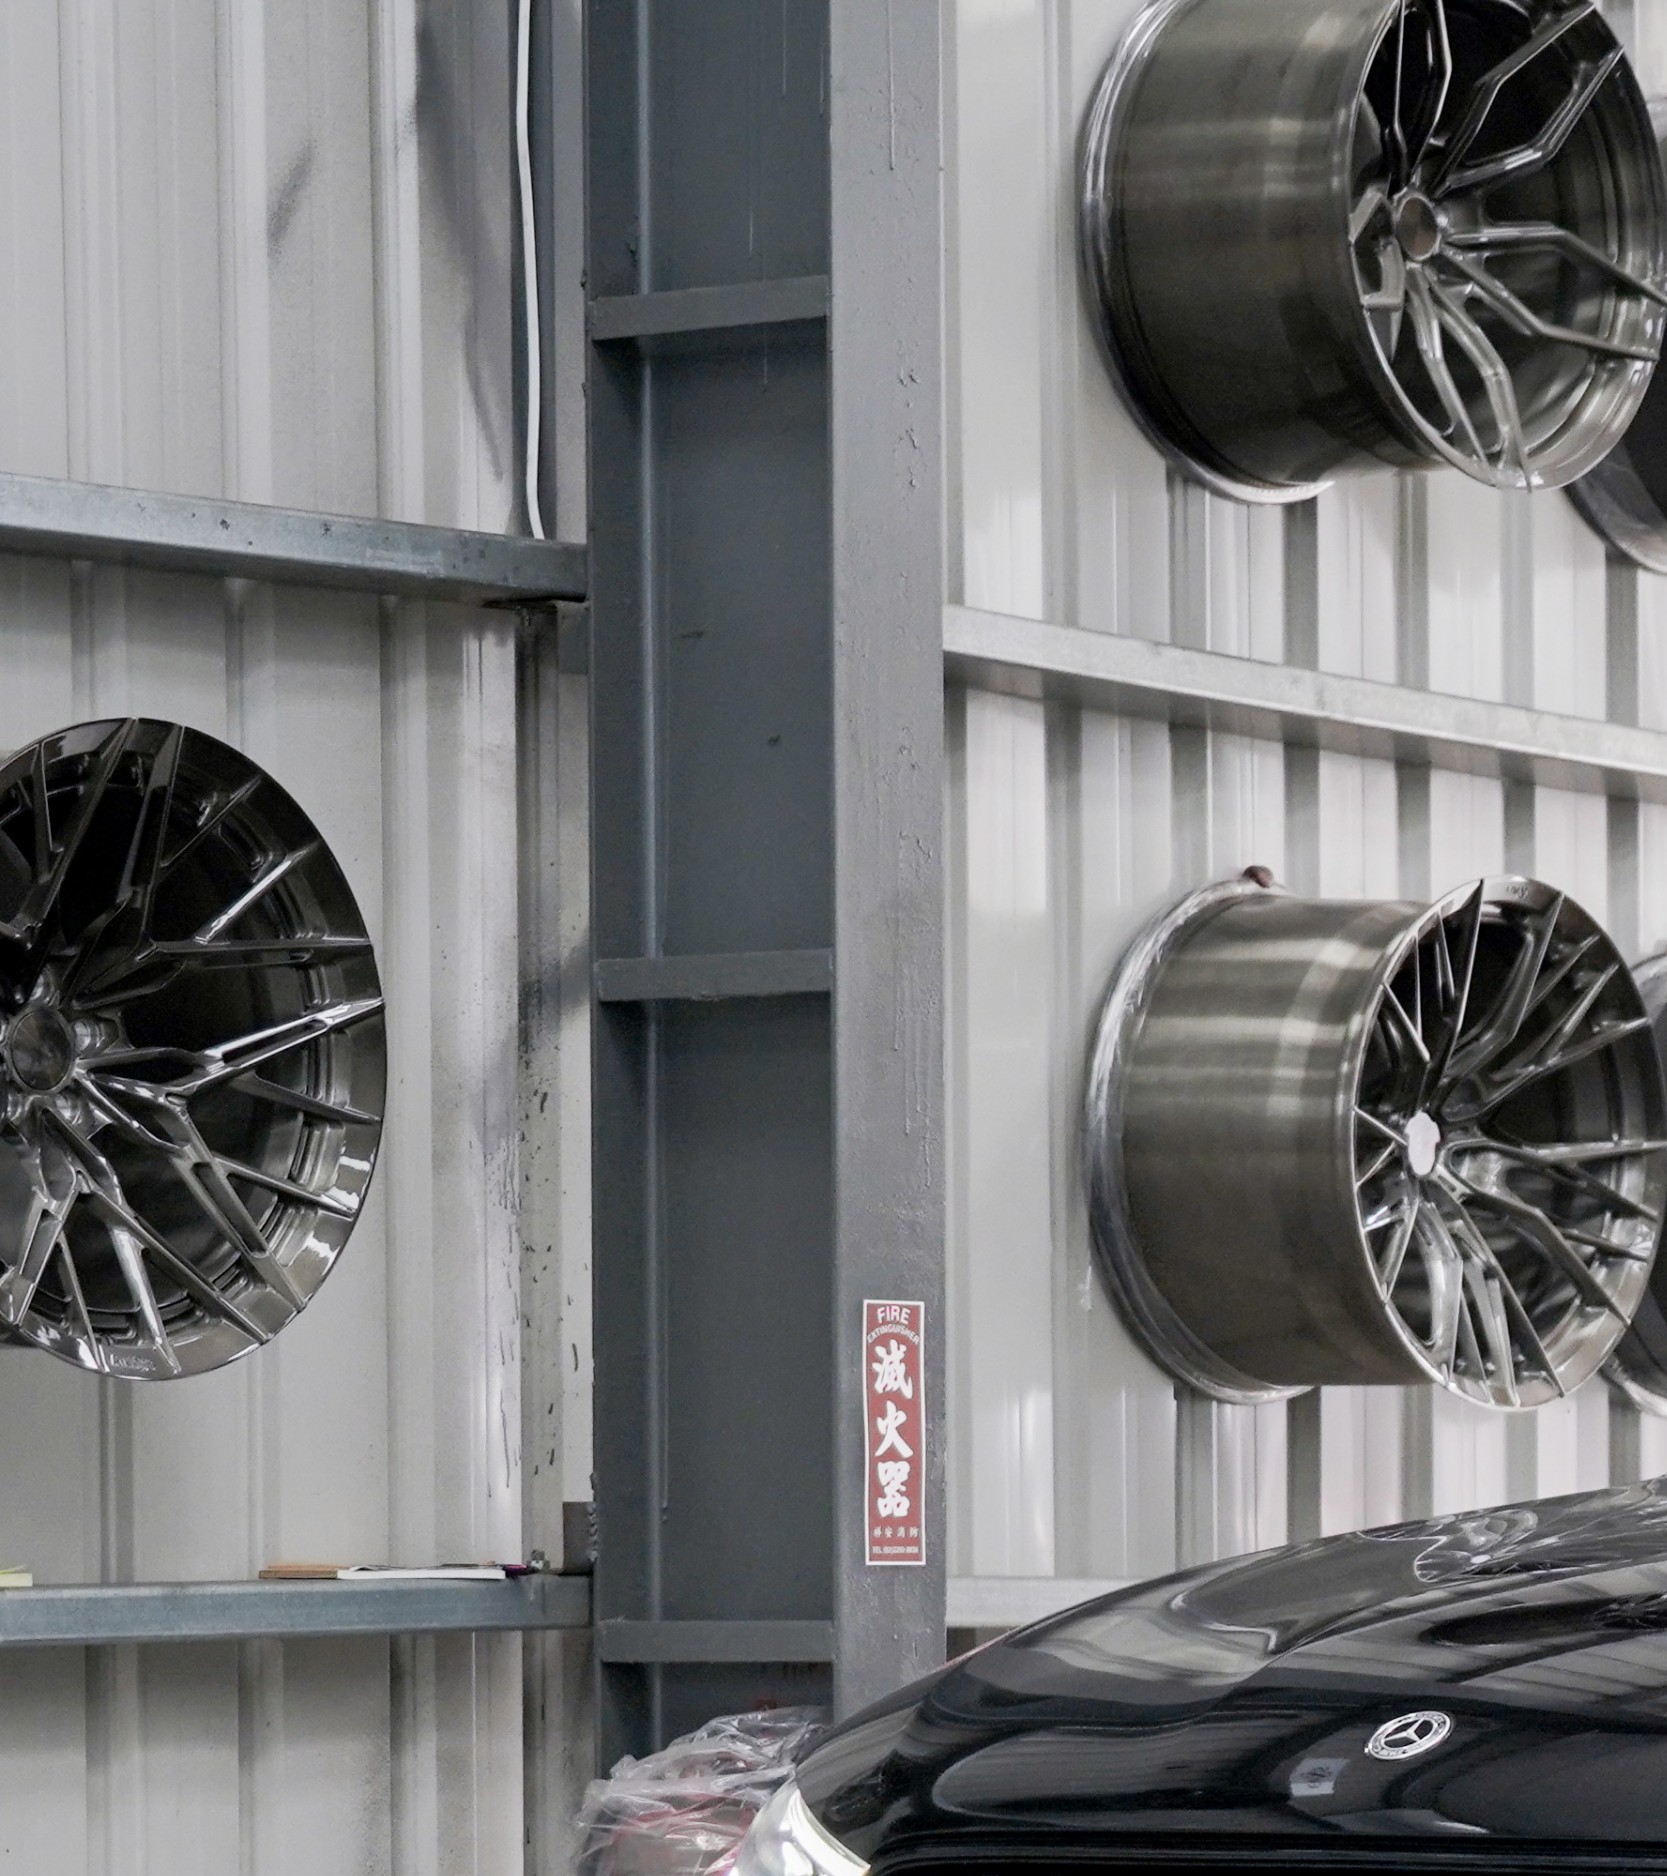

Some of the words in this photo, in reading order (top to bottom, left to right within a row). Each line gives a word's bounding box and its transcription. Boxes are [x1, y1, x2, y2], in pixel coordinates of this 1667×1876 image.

[877, 1305, 911, 1325] FIRE
[867, 1323, 920, 1345] EXTINGUISHER
[872, 1339, 914, 1518] 滅火器
